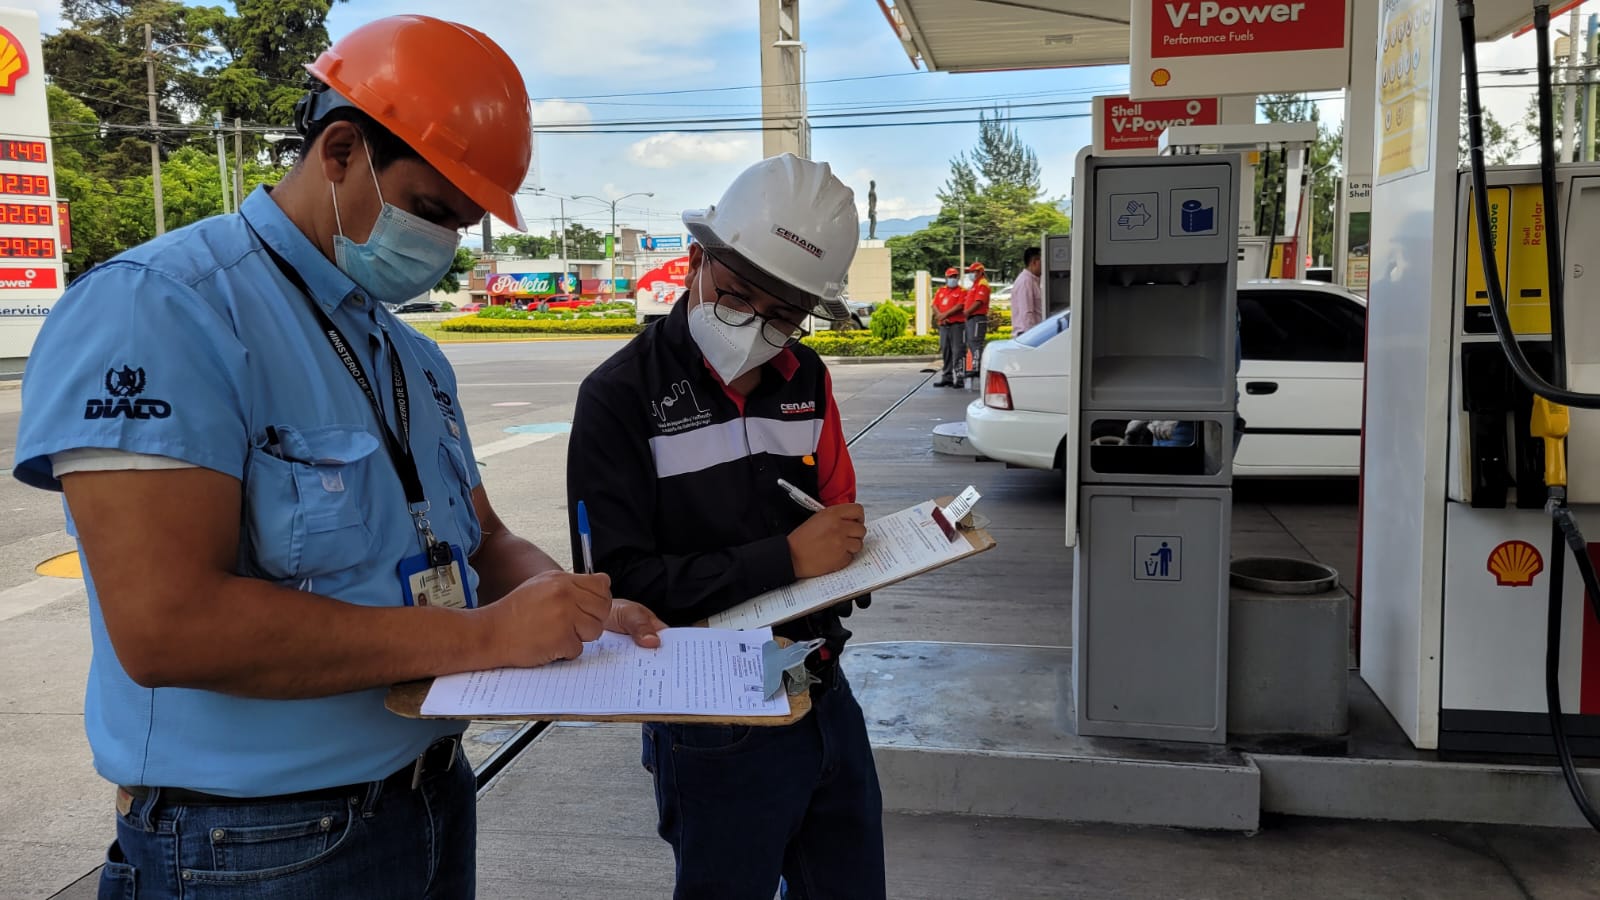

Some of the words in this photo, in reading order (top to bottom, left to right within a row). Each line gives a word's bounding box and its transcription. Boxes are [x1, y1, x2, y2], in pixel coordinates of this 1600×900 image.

[1165, 1, 1305, 28] V-Power
[1163, 33, 1226, 46] Performance
[1229, 31, 1254, 42] Fuels
[1111, 104, 1142, 117] Shell
[1111, 117, 1194, 133] V-Power
[1111, 135, 1149, 143] Performance
[0, 174, 49, 195] 2.39
[1349, 190, 1370, 198] Shell
[1490, 203, 1498, 251] uelSave
[1531, 202, 1544, 246] Regular
[776, 227, 823, 255] CENAME
[491, 275, 550, 293] Paleta
[328, 330, 360, 377] MINISTERIO
[84, 398, 171, 420] DIACO
